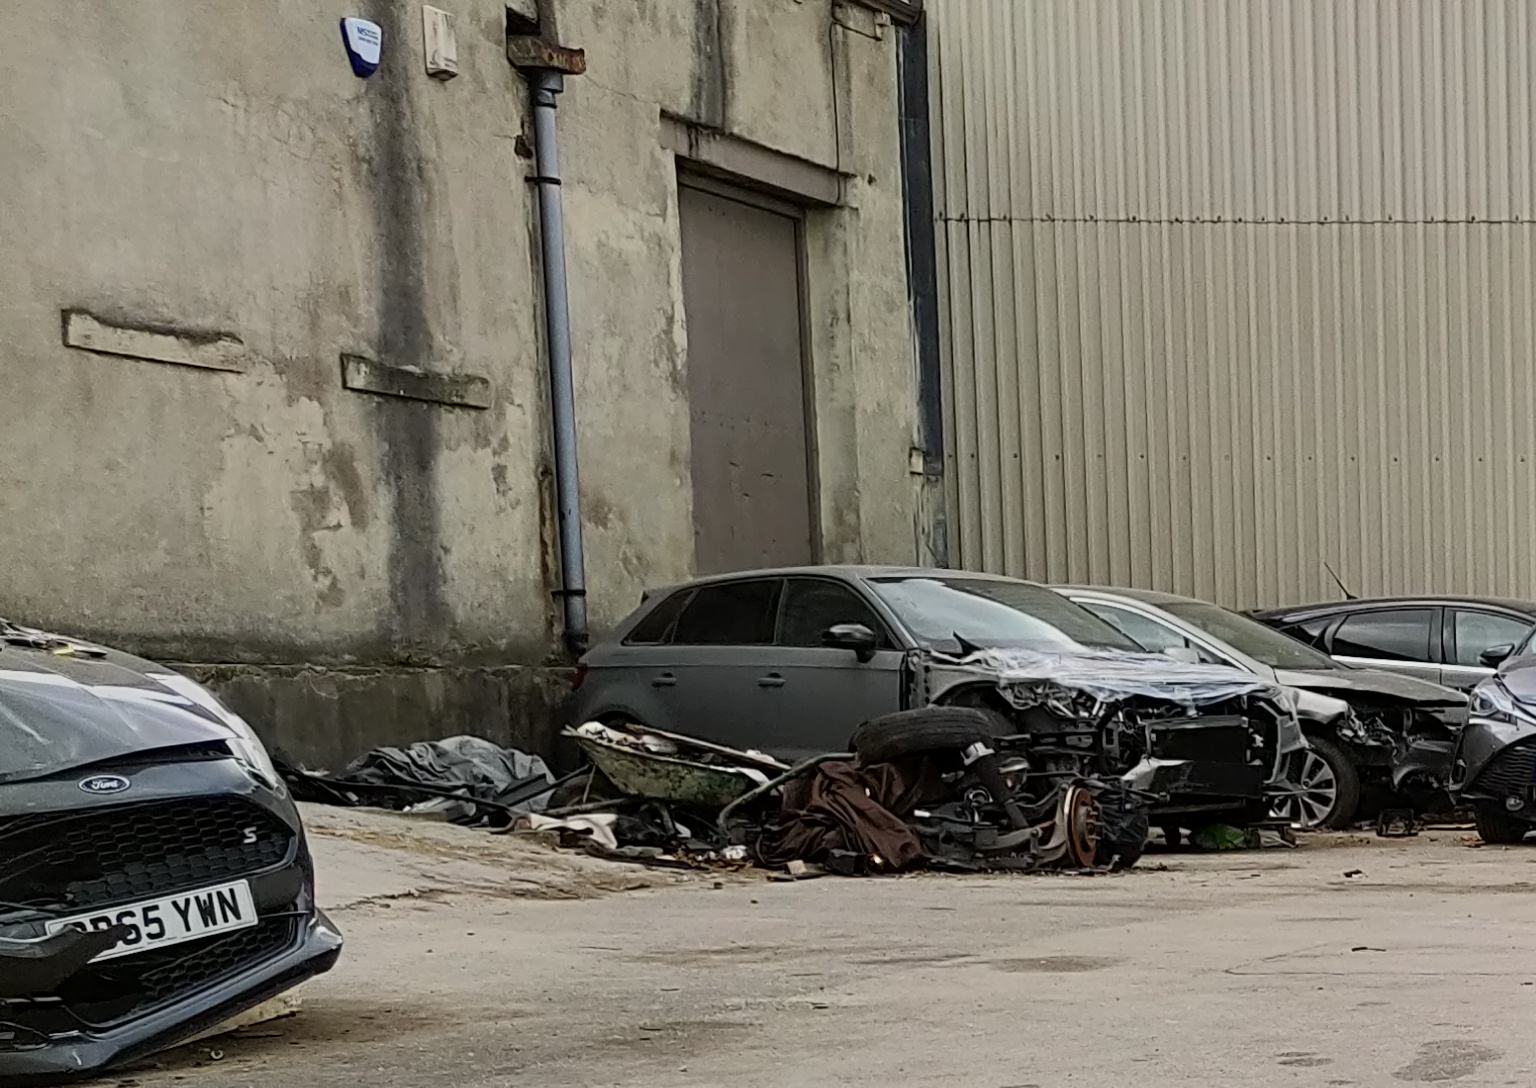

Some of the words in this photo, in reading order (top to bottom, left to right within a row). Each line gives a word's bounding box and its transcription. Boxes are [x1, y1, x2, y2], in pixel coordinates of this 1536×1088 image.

[90, 779, 119, 790] Ford
[63, 905, 165, 945] 65
[171, 887, 242, 932] YWN
